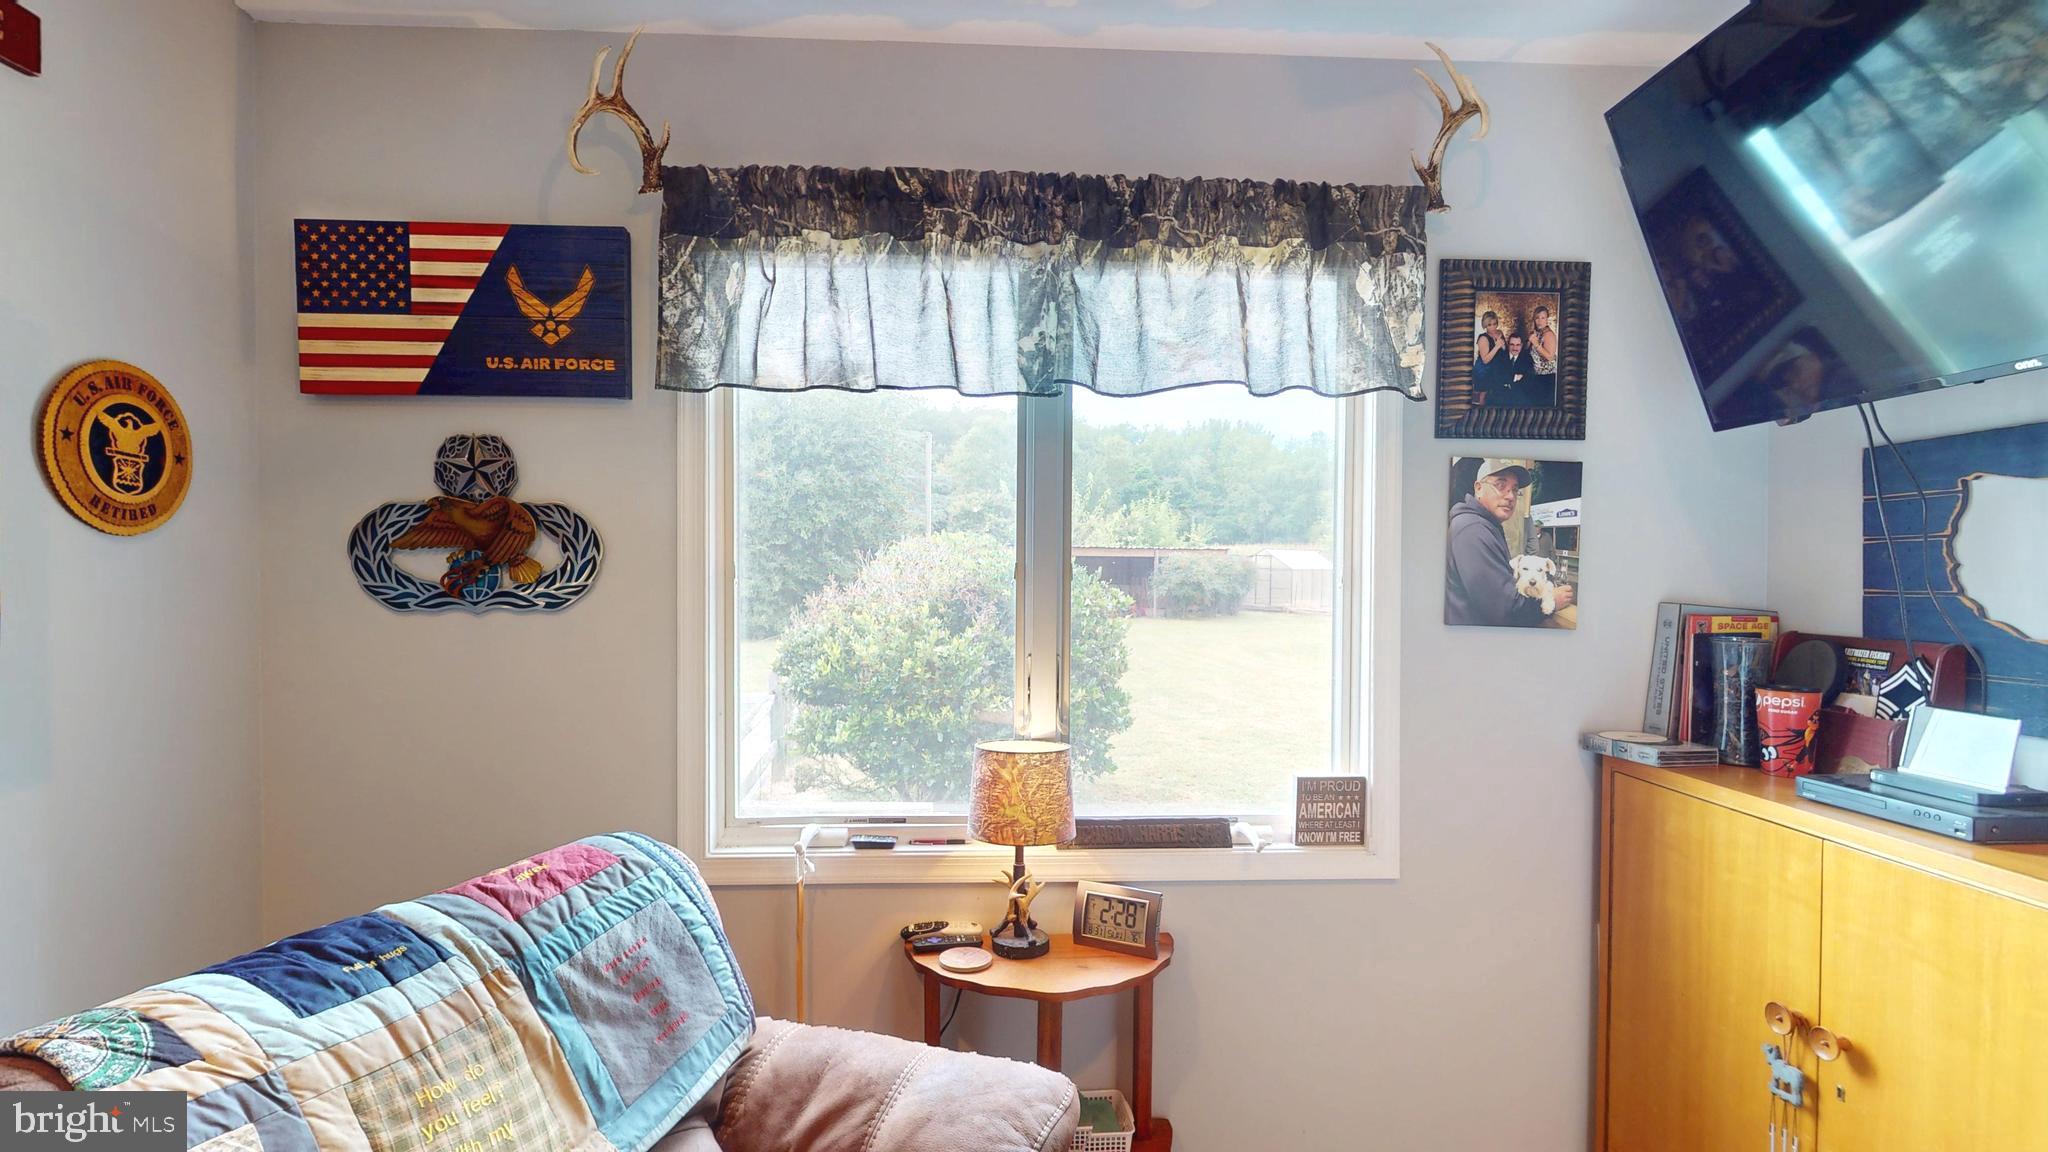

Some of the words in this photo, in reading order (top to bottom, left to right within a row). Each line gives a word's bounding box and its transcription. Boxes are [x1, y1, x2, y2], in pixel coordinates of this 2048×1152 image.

[485, 357, 519, 369] U.S.
[520, 358, 551, 369] AIR
[554, 358, 616, 371] FORCE
[73, 380, 103, 407] U.S.
[104, 375, 133, 391] AIR
[137, 382, 179, 431] FORCE
[89, 494, 157, 521] RETIRED
[1717, 622, 1748, 630] SPACE
[1751, 622, 1769, 630] AGE
[1661, 637, 1670, 674] UNITED
[1656, 678, 1666, 715] STATES
[1763, 696, 1804, 708] pepsi
[1301, 781, 1317, 792] I'M
[1320, 780, 1361, 792] PROUD
[1299, 802, 1360, 819] AMERICAN
[1298, 821, 1324, 829] WHERE
[1324, 821, 1333, 829] AT
[1335, 821, 1356, 829] LEAST
[1298, 831, 1325, 843] KNOW
[1325, 832, 1337, 842] I'M
[1339, 831, 1361, 842] FREE
[1099, 897, 1137, 929] 2:28
[379, 945, 408, 961] hugs
[415, 1076, 457, 1108] How
[463, 1063, 485, 1082] do
[421, 1110, 459, 1144] you
[463, 1080, 504, 1118] feel?
[488, 1119, 513, 1145] my
